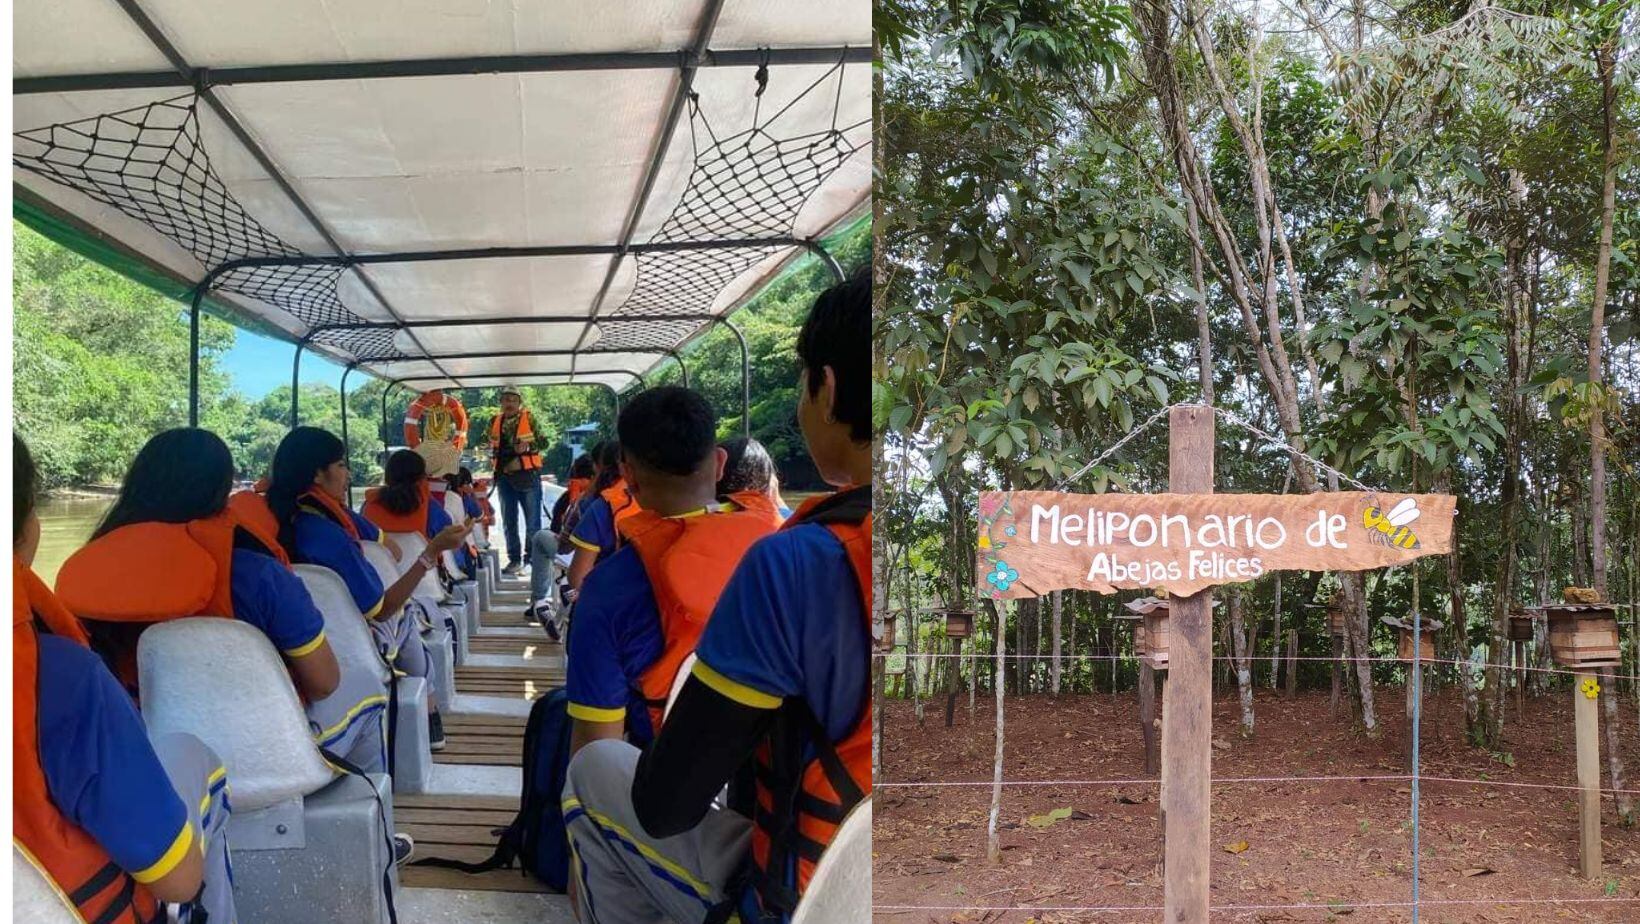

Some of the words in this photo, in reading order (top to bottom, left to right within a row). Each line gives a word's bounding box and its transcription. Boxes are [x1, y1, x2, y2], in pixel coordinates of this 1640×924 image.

[1304, 509, 1348, 549] de
[1087, 551, 1181, 585] Abejas
[1188, 550, 1264, 582] Felices
